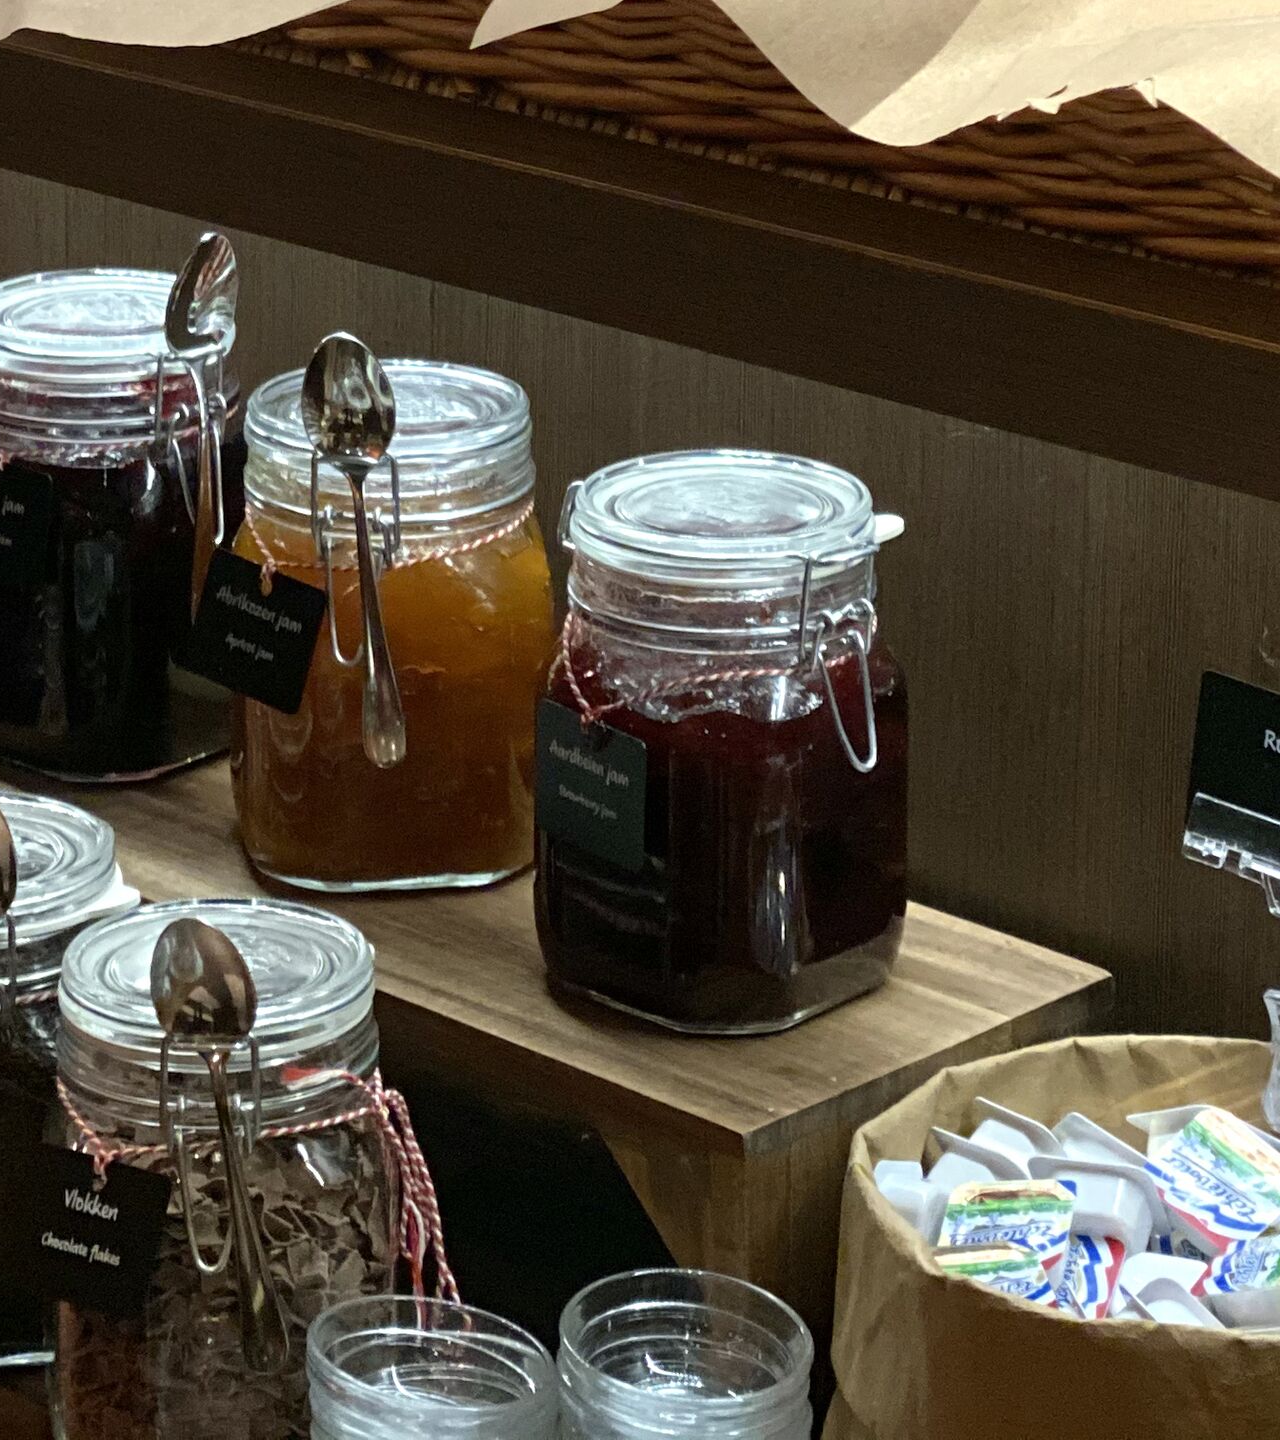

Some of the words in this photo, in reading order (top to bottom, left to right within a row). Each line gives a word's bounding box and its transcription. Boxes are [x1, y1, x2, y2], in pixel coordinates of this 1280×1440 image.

[275, 612, 303, 634] jam
[64, 1188, 119, 1221] Vlokken
[41, 1231, 89, 1258] Chocolate
